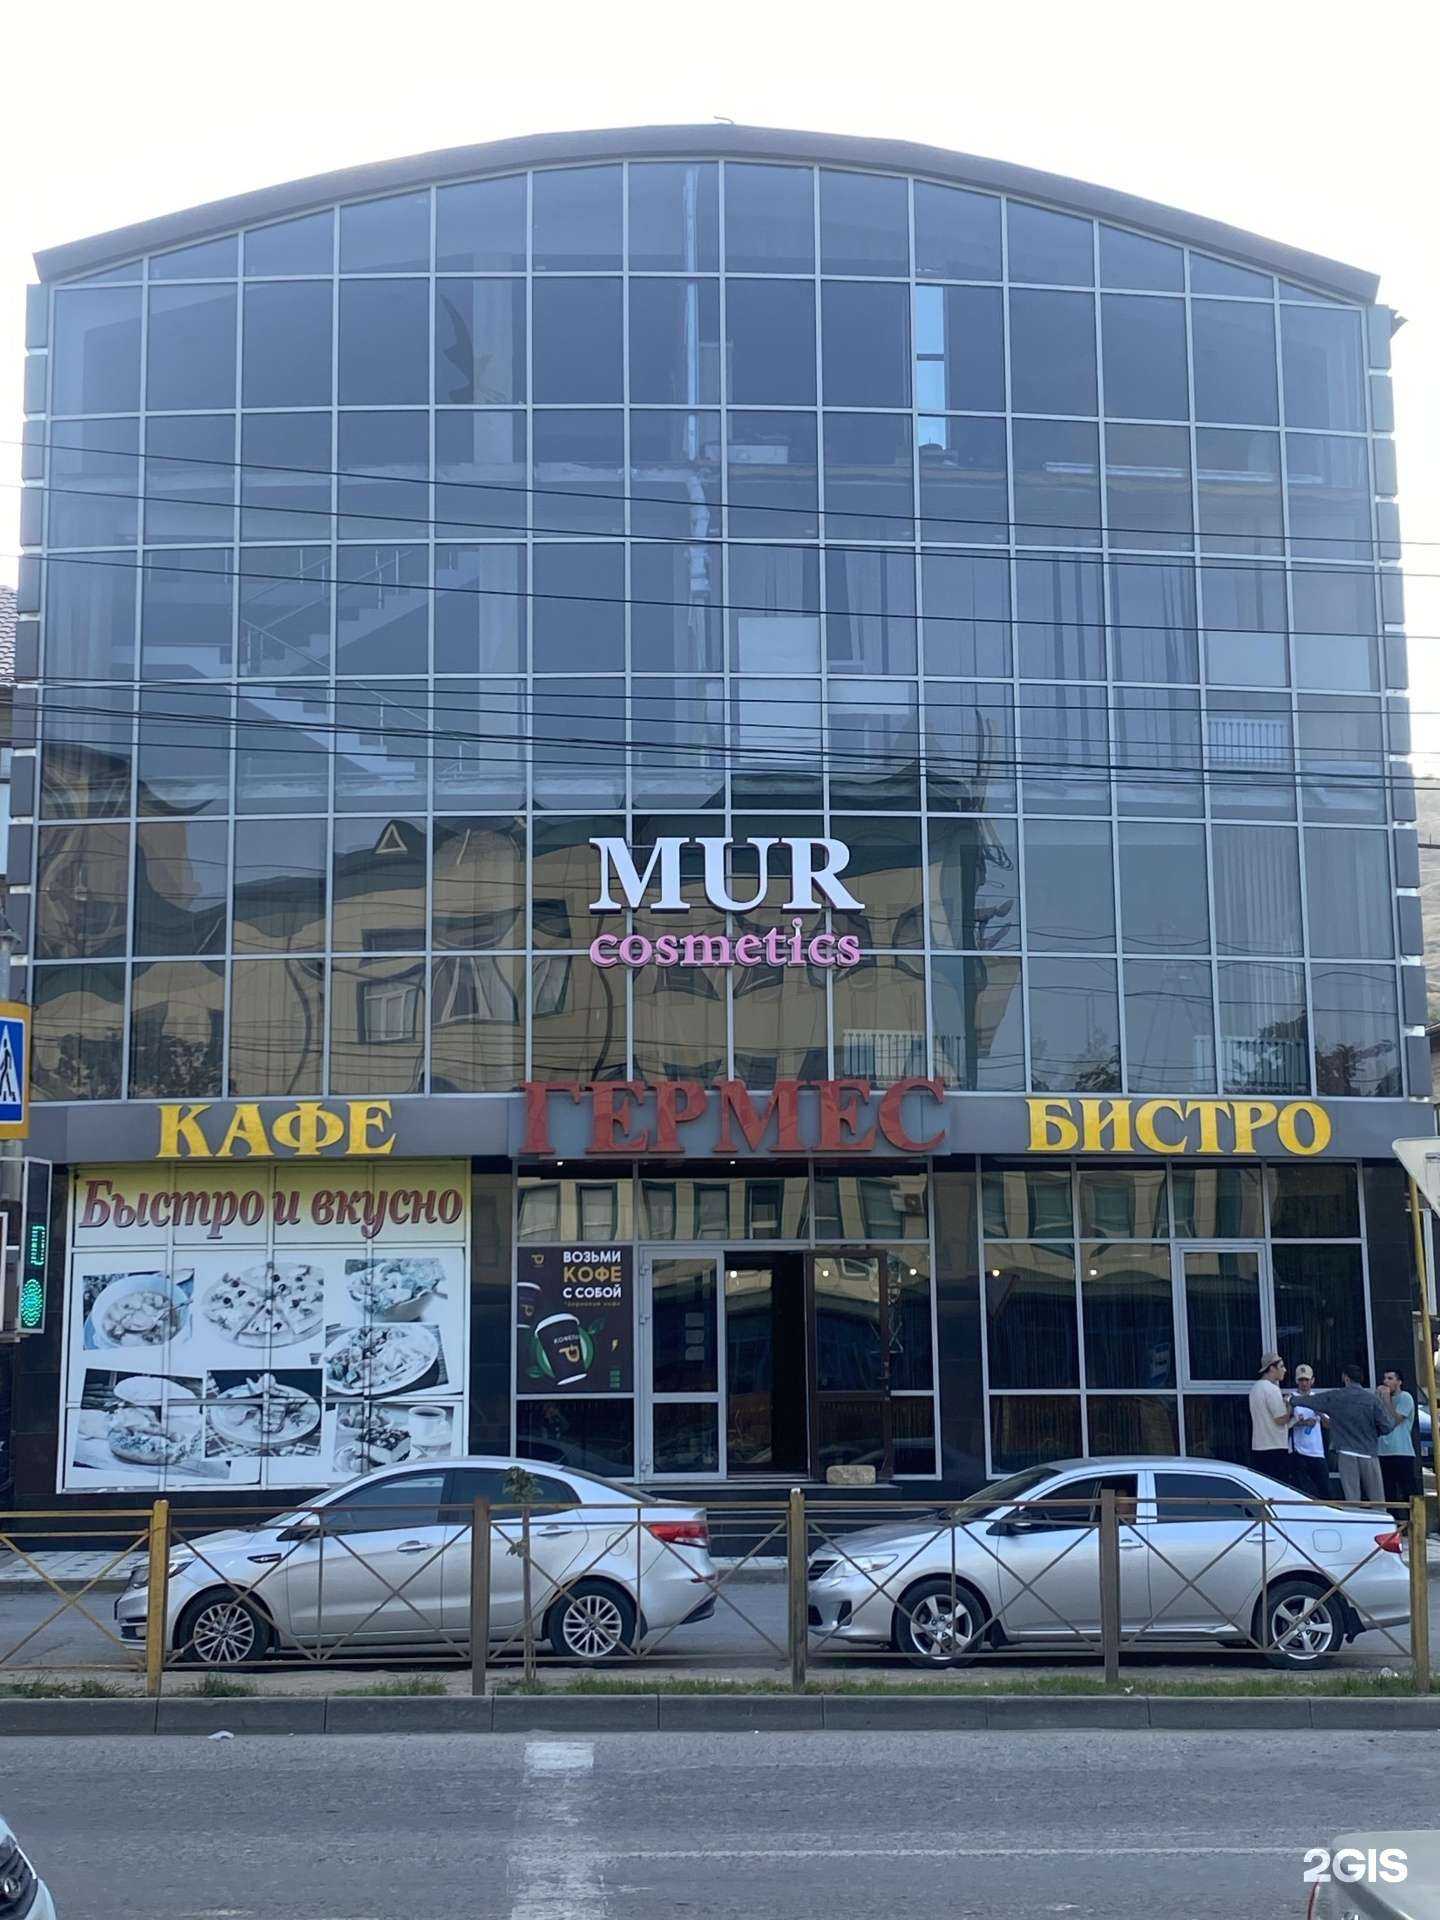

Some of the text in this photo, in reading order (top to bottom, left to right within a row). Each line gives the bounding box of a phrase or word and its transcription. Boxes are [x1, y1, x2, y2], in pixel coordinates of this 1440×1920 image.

[589, 837, 866, 915] MUR
[589, 917, 864, 967] cosmetics
[156, 1100, 397, 1158] КАФЕ
[519, 1079, 946, 1154] ГЕРМЕС
[1025, 1098, 1332, 1155] БИСТРО
[78, 1180, 464, 1240] Быстро и вкусно
[563, 1250, 621, 1263] ВОЗЬМИ
[563, 1265, 622, 1283] КОФЕ
[563, 1284, 622, 1299] С СОБОЙ
